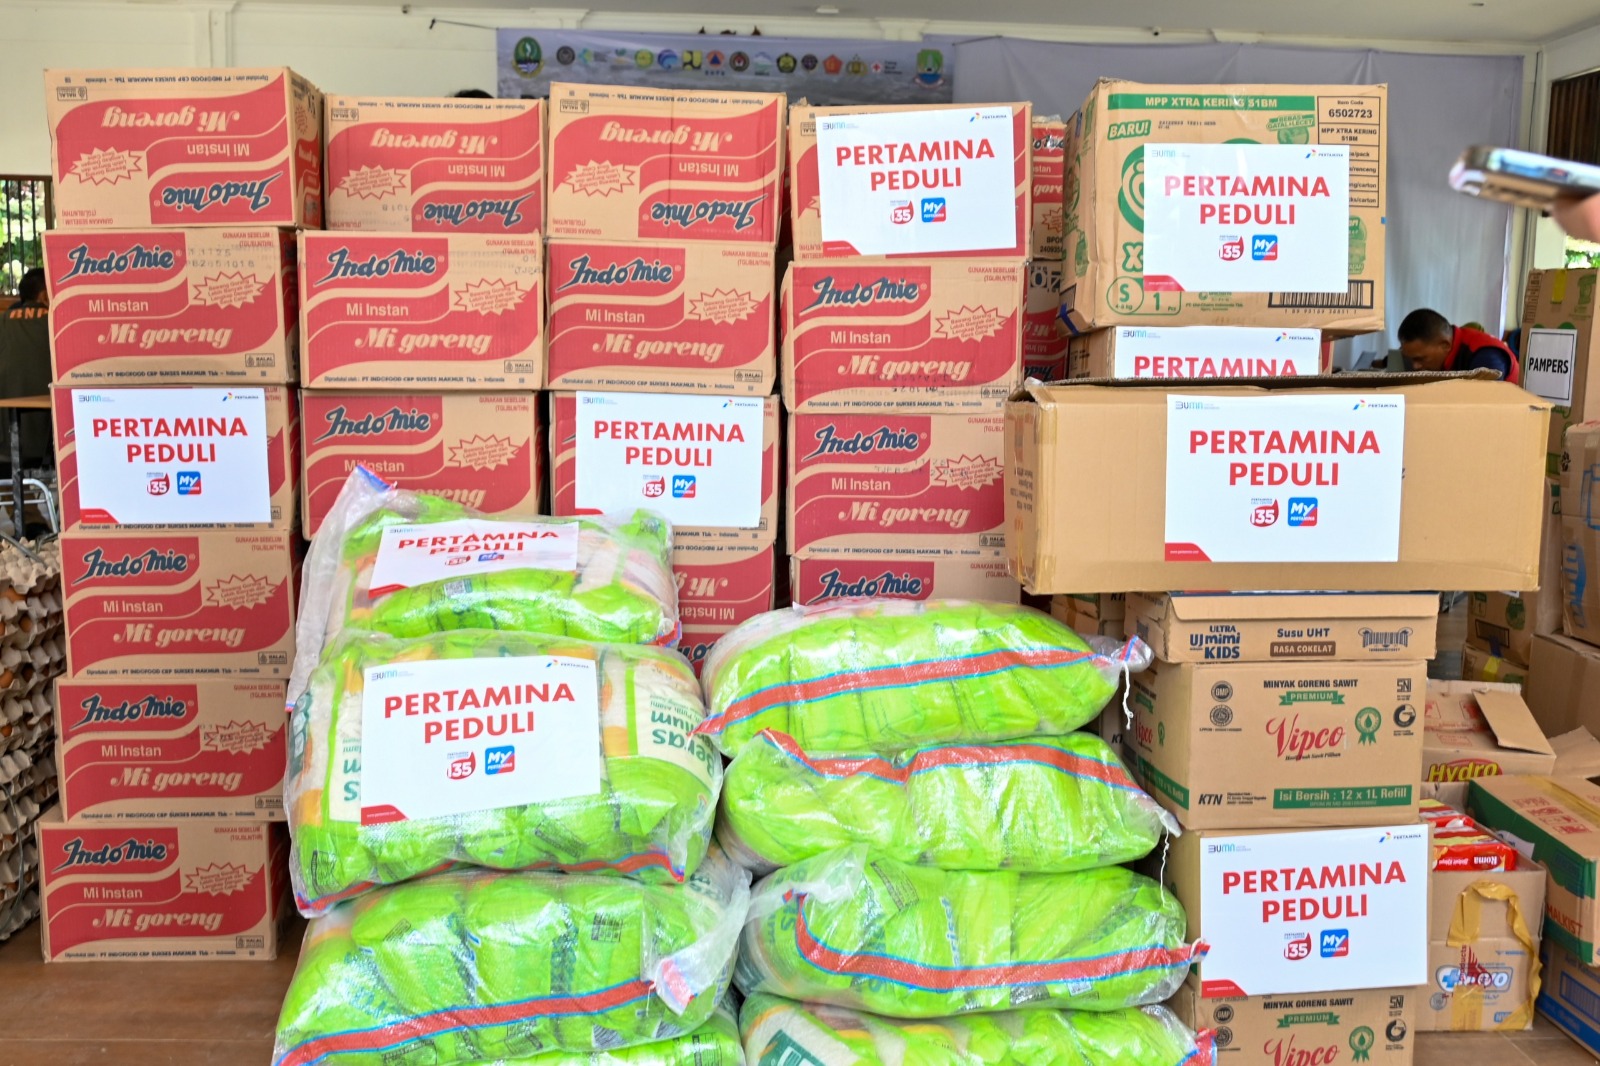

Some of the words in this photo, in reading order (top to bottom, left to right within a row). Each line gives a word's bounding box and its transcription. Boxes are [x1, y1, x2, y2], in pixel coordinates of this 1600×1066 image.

[1146, 97, 1168, 107] MPP
[1171, 97, 1200, 107] XTRA
[1203, 98, 1244, 108] KERING
[1248, 99, 1277, 107] S1BM
[101, 106, 194, 128] goreng
[196, 111, 240, 132] Mi
[1328, 108, 1373, 119] 6502723
[600, 121, 690, 143] goreng
[1109, 121, 1149, 137] BARU!
[371, 128, 457, 147] goreng
[459, 136, 497, 154] Mi
[691, 132, 732, 151] Mi
[187, 144, 229, 156] Instan
[233, 143, 249, 155] Mi
[836, 139, 995, 166] PERTAMINA
[448, 165, 484, 176] Instan
[490, 165, 505, 176] Mi
[679, 163, 720, 175] Instan
[723, 164, 738, 176] Mi
[871, 167, 962, 191] PEDULI
[1165, 176, 1330, 197] PERTAMINA
[923, 201, 944, 214] My
[1200, 204, 1295, 224] PEDULI
[1254, 238, 1276, 251] My
[1119, 284, 1129, 302] S
[89, 300, 104, 311] Mi
[108, 299, 148, 311] Instan
[347, 303, 362, 315] Mi
[366, 303, 408, 316] Instan
[1153, 293, 1160, 310] 1
[586, 309, 601, 321] Mi
[604, 309, 645, 323] Instan
[98, 323, 139, 344] Mi
[139, 327, 233, 349] goreng
[355, 328, 395, 347] Mi
[399, 333, 492, 354] goreng
[831, 331, 846, 343] Mi
[850, 331, 891, 344] Instan
[593, 333, 634, 352] Mi
[634, 338, 724, 362] goreng
[838, 355, 880, 375] Mi
[879, 359, 971, 380] goreng
[1134, 356, 1298, 377] PERTAMINA
[1529, 358, 1568, 374] PAMPERS
[93, 418, 248, 437] PERTAMINA
[594, 421, 744, 442] PERTAMINA
[1190, 430, 1380, 453] PERTAMINA
[127, 444, 215, 462] PEDULI
[626, 447, 712, 466] PEDULI
[179, 475, 198, 486] My
[1229, 463, 1338, 485] PEDULI
[674, 479, 693, 490] My
[832, 478, 847, 490] Mi
[850, 478, 890, 490] Instan
[838, 501, 880, 521] Mi
[879, 507, 970, 528] goreng
[1291, 503, 1315, 515] My
[399, 530, 559, 549] PERTAMINA
[430, 542, 524, 555] PEDULI
[104, 601, 120, 613] Mi
[122, 601, 163, 612] Instan
[720, 608, 734, 620] Mi
[113, 623, 155, 642] Mi
[155, 627, 245, 648] goreng
[1277, 629, 1303, 637] Susu
[1307, 628, 1329, 637] UHT
[1204, 646, 1240, 659] KIDS
[1274, 645, 1295, 653] RASA
[1297, 644, 1332, 653] COKELAT
[1264, 680, 1295, 688] MINYAK
[1298, 680, 1330, 688] GORENG
[384, 683, 575, 718] PERTAMINA
[424, 712, 534, 744] PEDULI
[1266, 713, 1344, 761] Vipco
[102, 746, 118, 757] Mi
[121, 746, 161, 757] Instan
[488, 752, 510, 763] My
[111, 767, 151, 787] Mi
[152, 772, 242, 791] goreng
[1428, 762, 1498, 782] Hydro
[1199, 794, 1222, 805] KTN
[1280, 791, 1292, 801] Isi
[1296, 790, 1330, 800] Bersih
[1340, 790, 1352, 800] 12
[1356, 791, 1362, 799] x
[1367, 789, 1378, 799] 1L
[1381, 788, 1407, 798] Refill
[1223, 861, 1405, 894] PERTAMINA
[84, 887, 99, 898] Mi
[103, 887, 142, 898] Instan
[1262, 894, 1367, 923] PEDULI
[93, 909, 133, 927] Mi
[134, 911, 224, 931] goreng
[1323, 935, 1345, 947] My
[1264, 1000, 1293, 1009] MINYAK
[1296, 999, 1327, 1007] GORENG
[1330, 998, 1353, 1006] SAWIT
[1288, 1013, 1330, 1022] PREMIUM
[1264, 1034, 1339, 1066] Vipco
